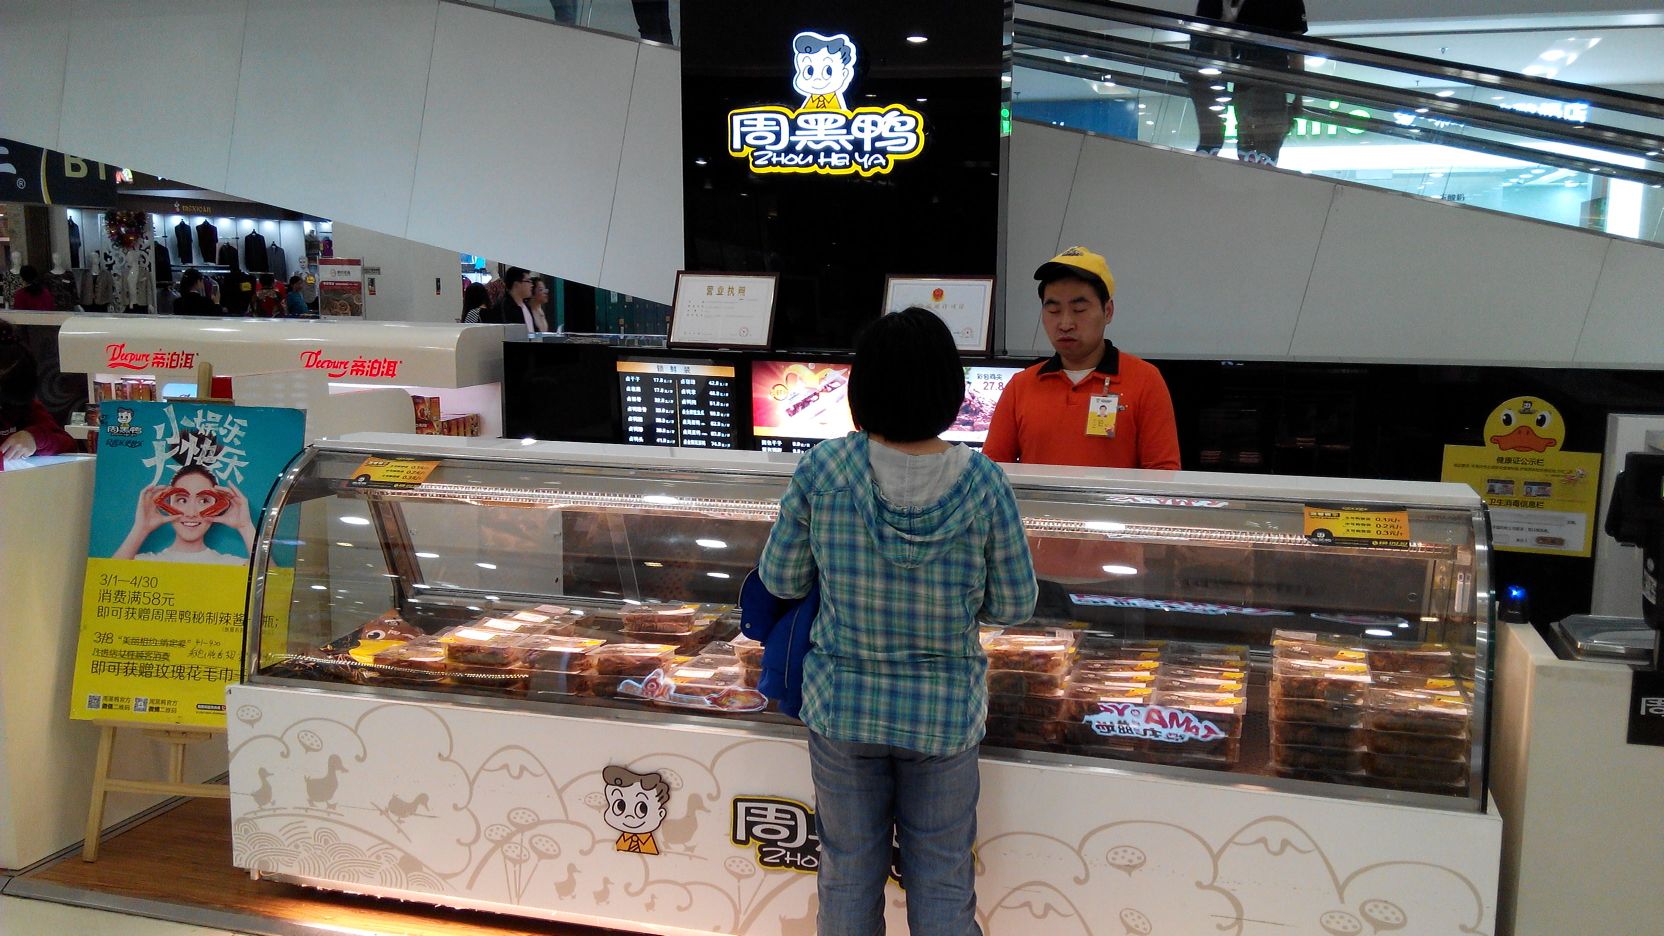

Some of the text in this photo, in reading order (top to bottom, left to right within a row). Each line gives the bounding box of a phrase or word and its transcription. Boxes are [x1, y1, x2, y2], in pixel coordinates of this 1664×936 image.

[732, 112, 917, 152] 周黑鸭
[753, 151, 887, 168] ZHOU HEI YA
[706, 285, 746, 296] 营业执照
[152, 349, 195, 369] 帝泊洱
[350, 355, 397, 378] 帝泊洱
[983, 381, 1005, 391] 27.8
[153, 404, 248, 446] 小娱乐
[1496, 456, 1545, 467] 健康证公示栏
[1488, 498, 1545, 509] 卫生消毒信息栏
[97, 589, 176, 607] 消费满58元
[762, 847, 818, 867] ZHO
